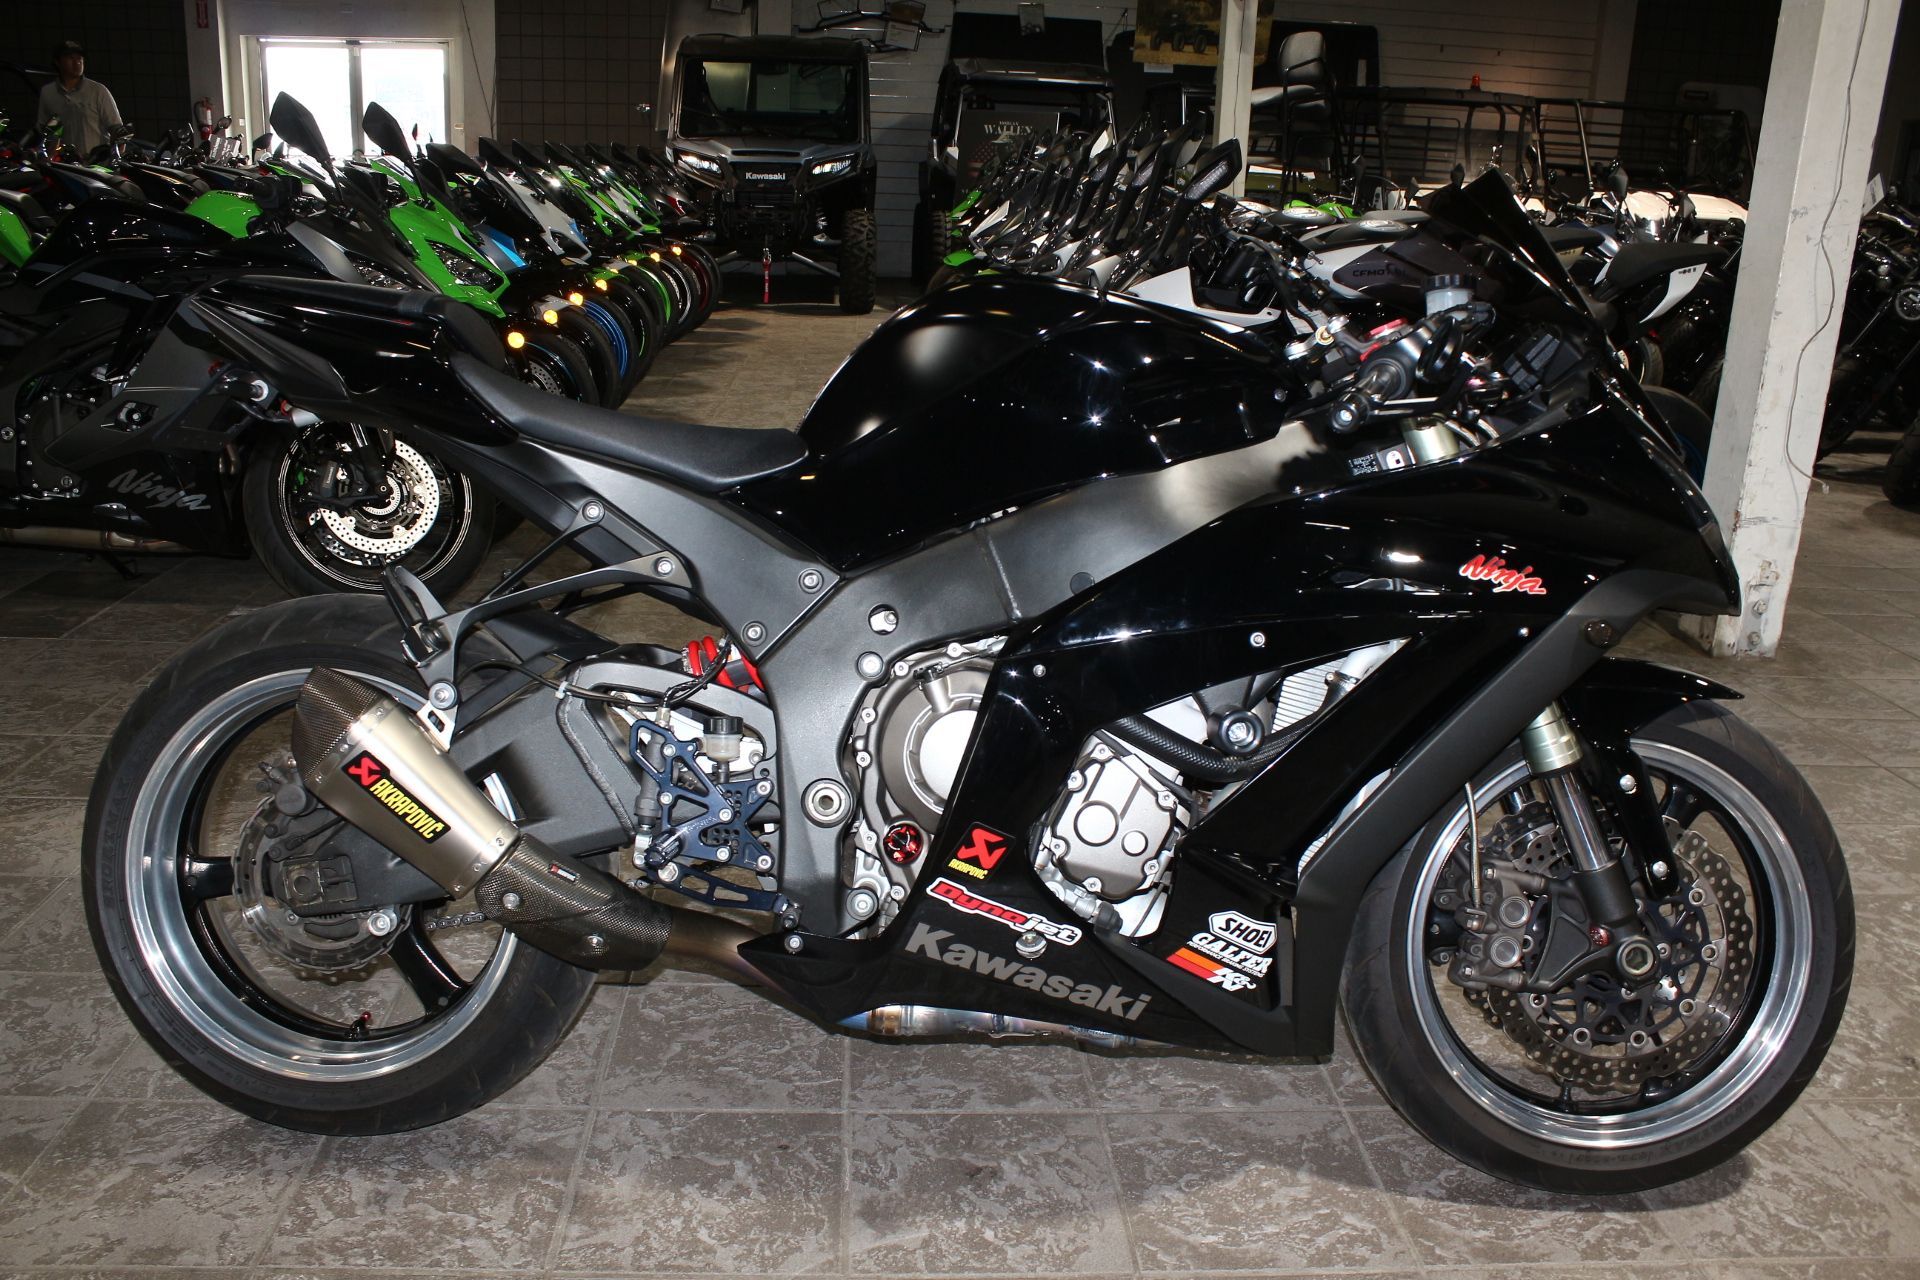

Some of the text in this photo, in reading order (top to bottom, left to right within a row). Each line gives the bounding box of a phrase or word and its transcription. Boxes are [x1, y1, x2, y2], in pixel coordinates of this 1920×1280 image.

[745, 172, 786, 180] Kawasaki
[107, 468, 211, 511] Ninja
[1459, 554, 1547, 595] Ninja
[931, 880, 1079, 944] Dynojet
[1218, 917, 1273, 949] SHOEI
[904, 922, 1153, 1022] Kawasaki
[1191, 932, 1273, 974] GALFER
